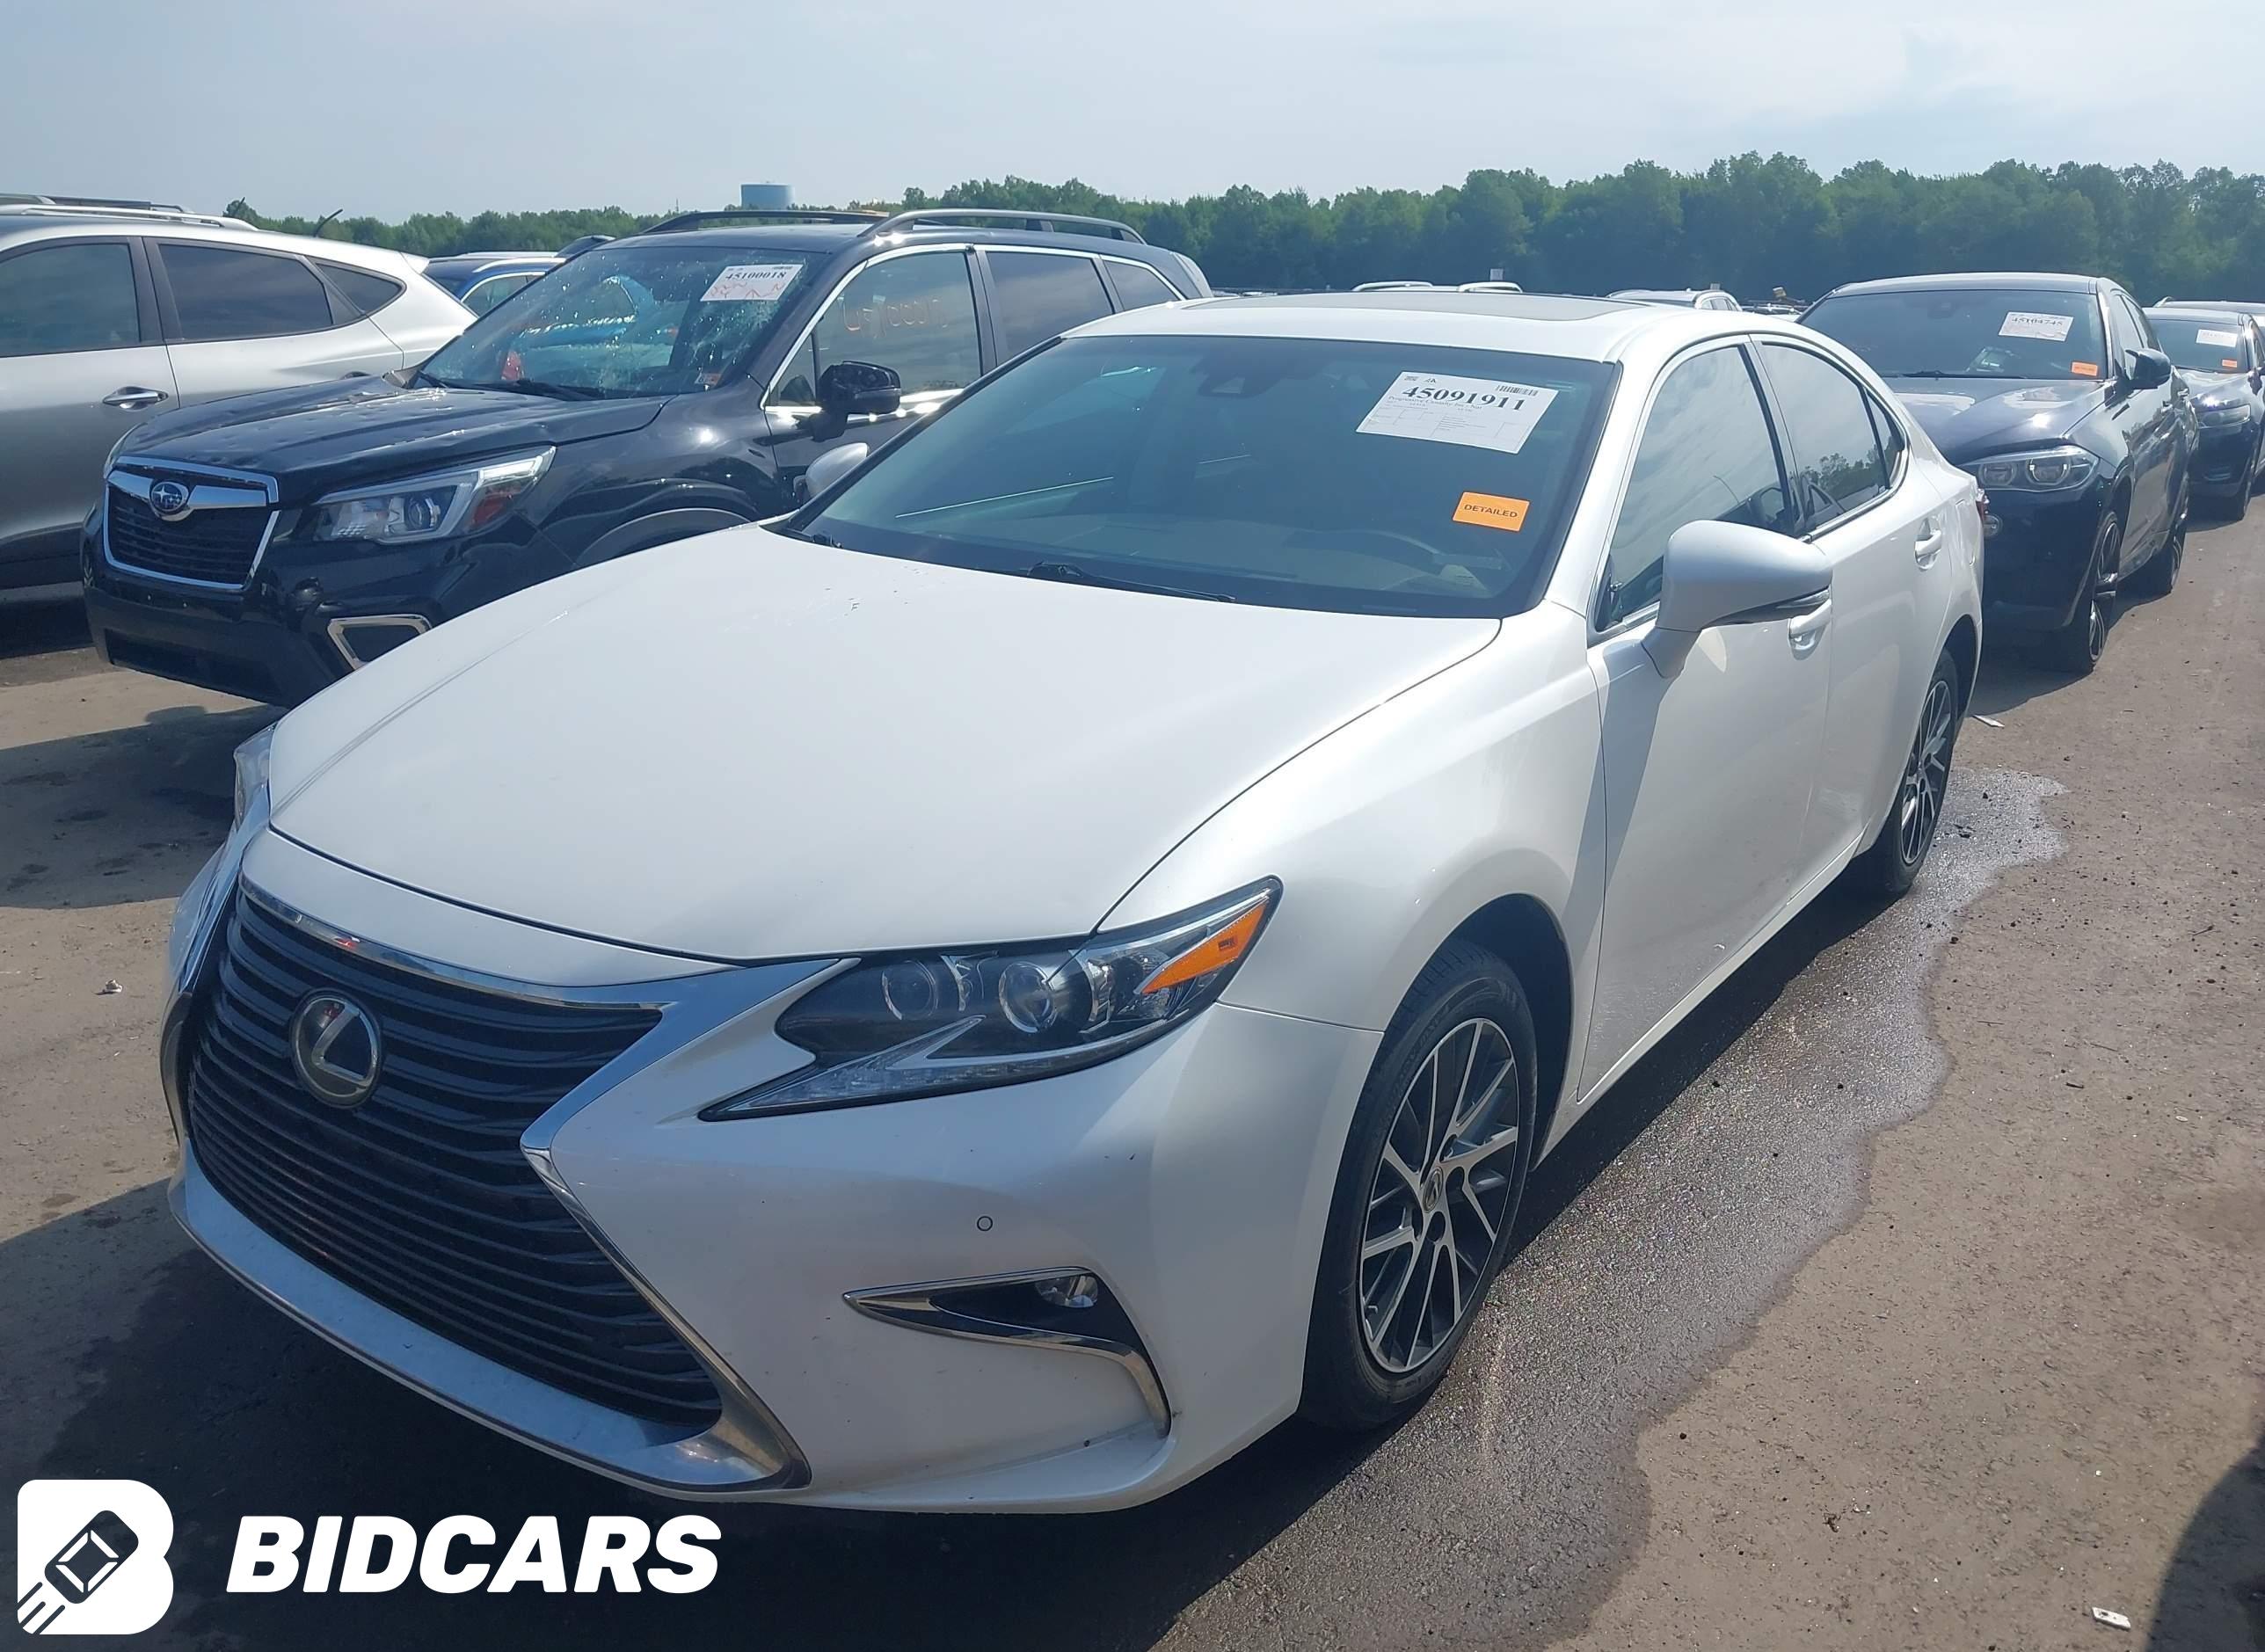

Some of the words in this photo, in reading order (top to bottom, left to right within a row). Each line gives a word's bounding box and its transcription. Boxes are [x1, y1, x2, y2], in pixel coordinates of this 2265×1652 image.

[725, 271, 787, 280] 45100018
[1402, 387, 1525, 411] 45091911
[1464, 504, 1518, 517] DETAILED
